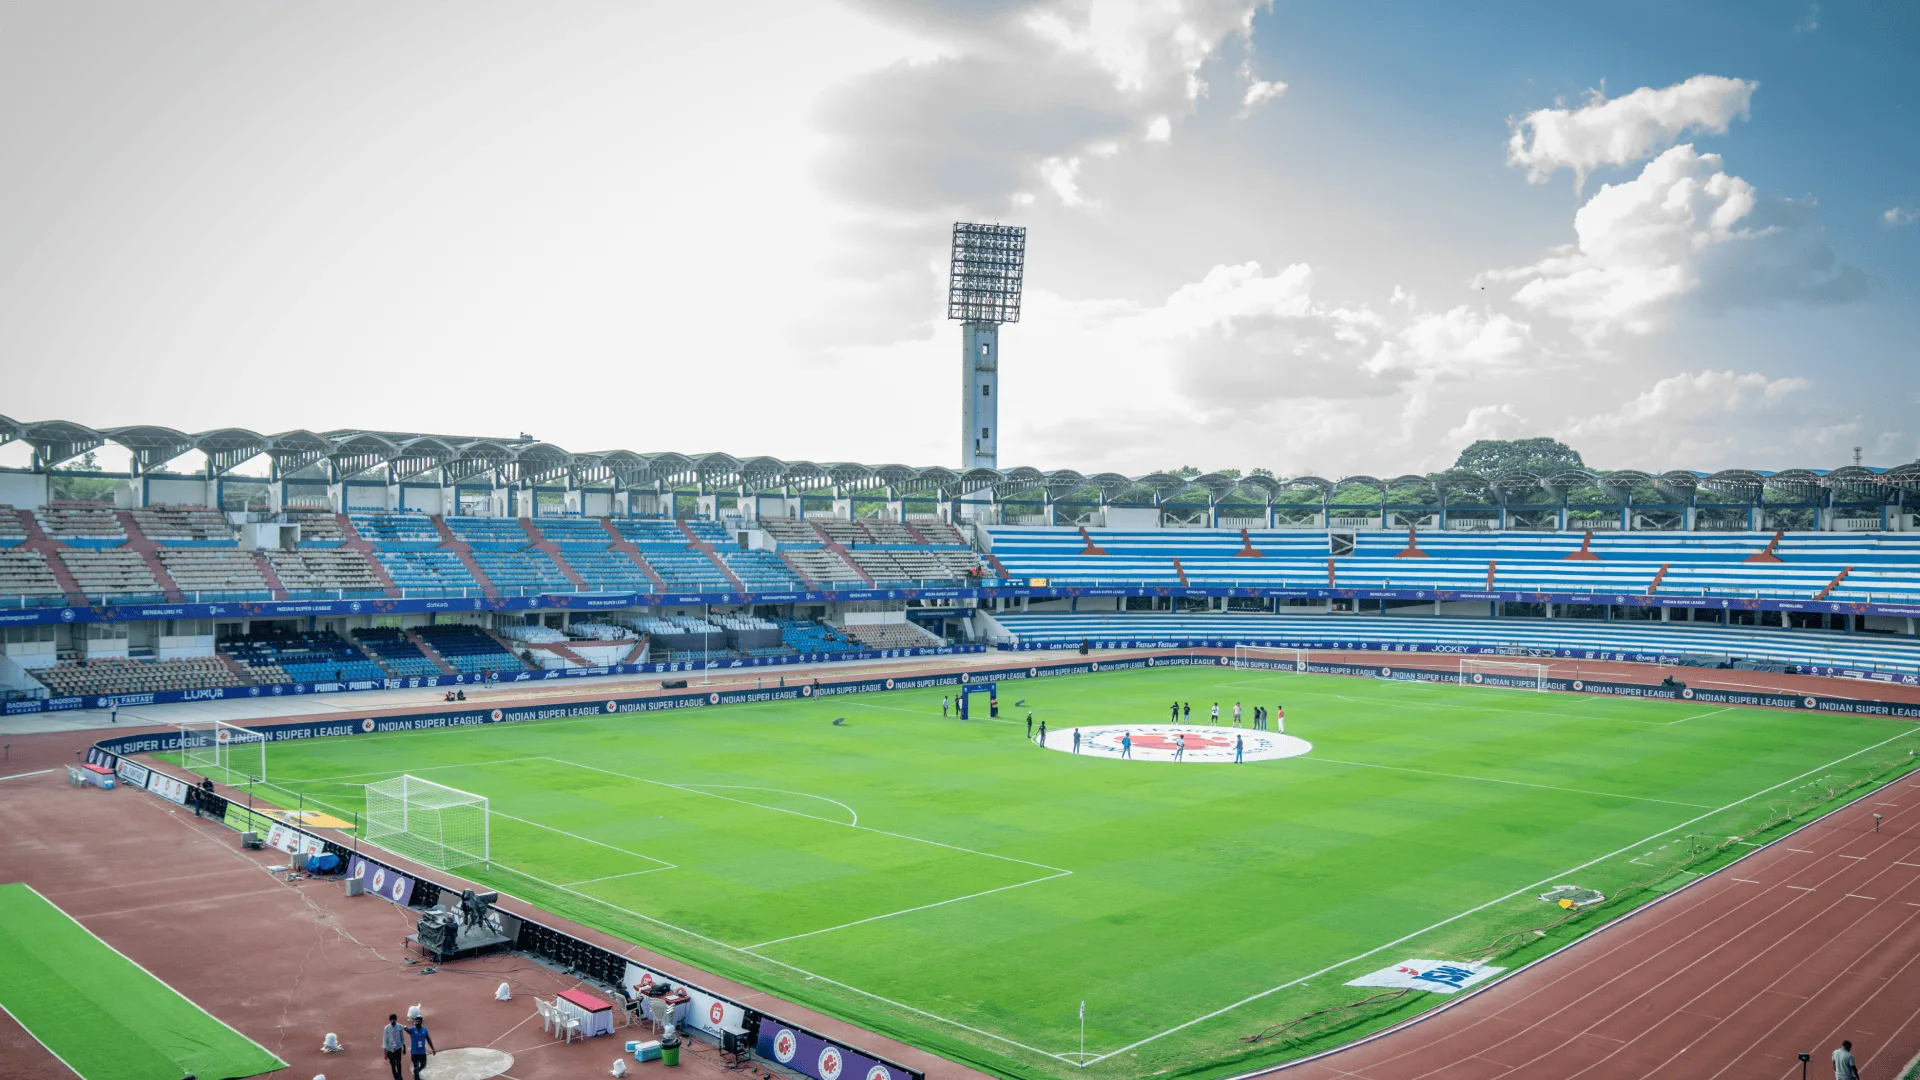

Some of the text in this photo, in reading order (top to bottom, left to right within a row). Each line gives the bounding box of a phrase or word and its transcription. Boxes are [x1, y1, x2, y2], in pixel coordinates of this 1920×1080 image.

[1431, 645, 1469, 653] JOCKEY
[1130, 661, 1145, 669] LEAGUE
[1190, 658, 1216, 666] LEAGUE
[1264, 663, 1293, 671] LEAGUE
[1037, 669, 1055, 677] INDIAN
[1071, 666, 1088, 674] LEAGUE
[1306, 664, 1377, 677] INDIAN SUPER LEAGUE
[970, 671, 1026, 683] INDIAN SUPER LEAGUE
[1392, 671, 1415, 680] INDIAN
[1416, 672, 1439, 682] SUPER
[1902, 675, 1918, 684] ARC
[314, 684, 338, 692] PUMA
[349, 681, 372, 690] PUMA
[408, 680, 419, 688] 18
[427, 678, 437, 687] 18
[895, 677, 958, 690] INDIAN SUPER LEAGUE
[1484, 677, 1510, 687] INDIAN
[1511, 679, 1536, 689] SUPER
[835, 686, 857, 695] SUPER
[857, 683, 882, 693] LEAGUE
[1585, 684, 1675, 699] INDIAN SUPER LEAGUE
[49, 697, 82, 706] RADISSON
[121, 695, 154, 704] FANTASY
[721, 691, 798, 704] INDIAN SUPER LEAGUE
[1695, 692, 1796, 708] INDIAN SUPER LEAGUE
[6, 700, 41, 710] RADISSON
[619, 698, 704, 712] INDIAN SUPER LEAGUE
[1819, 701, 1854, 713] INDIAN
[1855, 703, 1889, 715] SUPER
[505, 706, 600, 722] INDIAN SUPER LEAGUE
[378, 715, 484, 732] INDIAN SUPER LEAGUE
[276, 728, 311, 740] SUPER
[313, 726, 353, 737] LEAGUE
[123, 741, 158, 753] SUPER
[162, 737, 207, 751] LEAGUE
